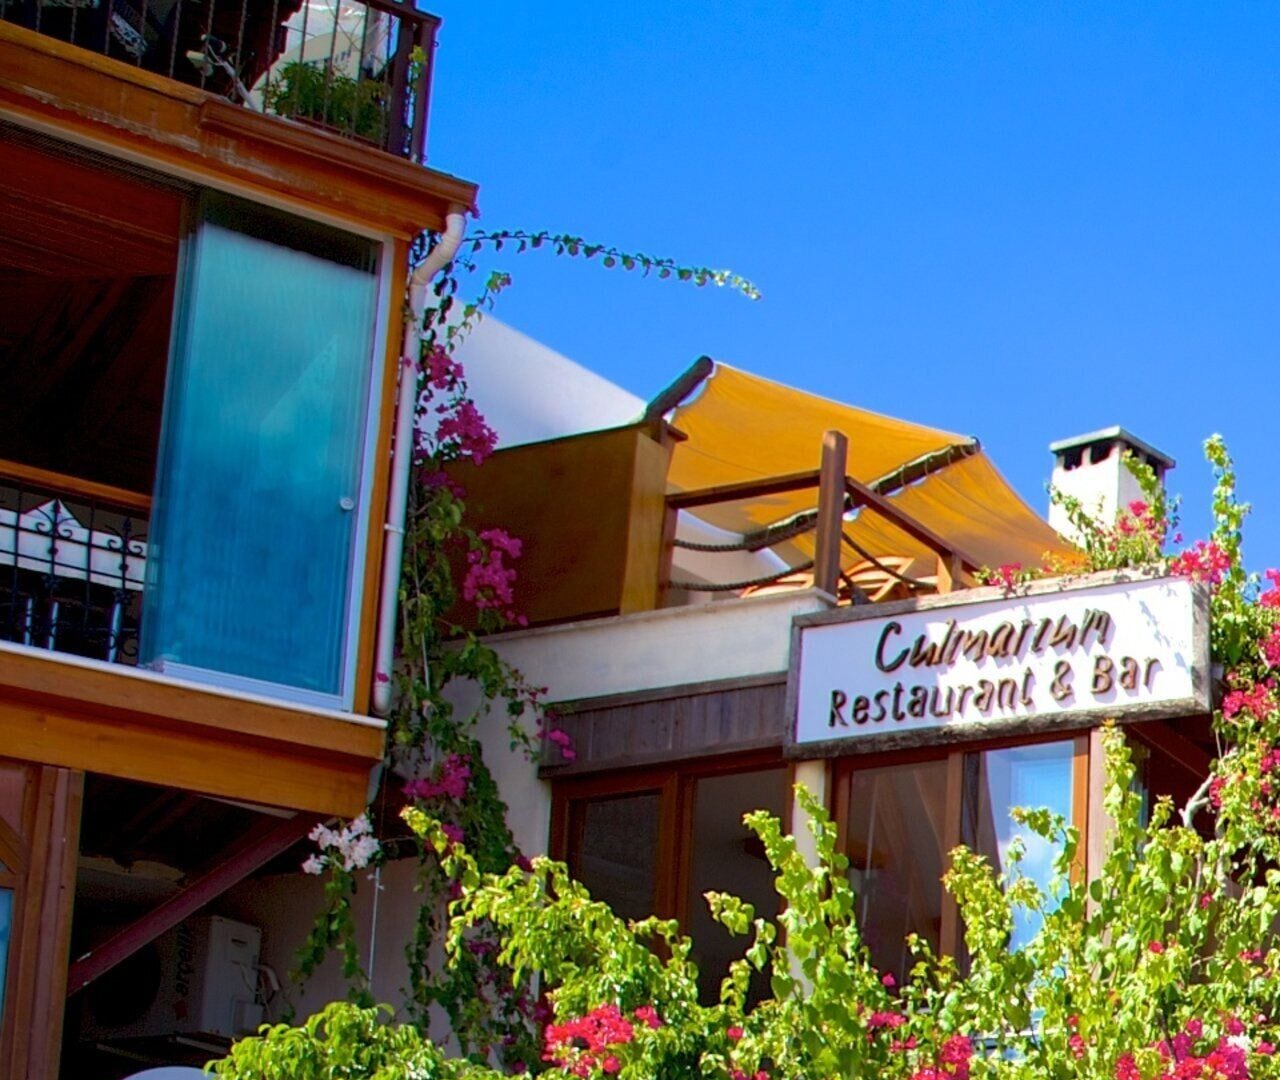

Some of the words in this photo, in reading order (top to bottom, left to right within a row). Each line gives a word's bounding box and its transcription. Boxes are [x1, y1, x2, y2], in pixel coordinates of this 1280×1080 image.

[828, 662, 1034, 728] Restaurant
[1050, 660, 1074, 701] &
[1090, 653, 1162, 695] Bar
